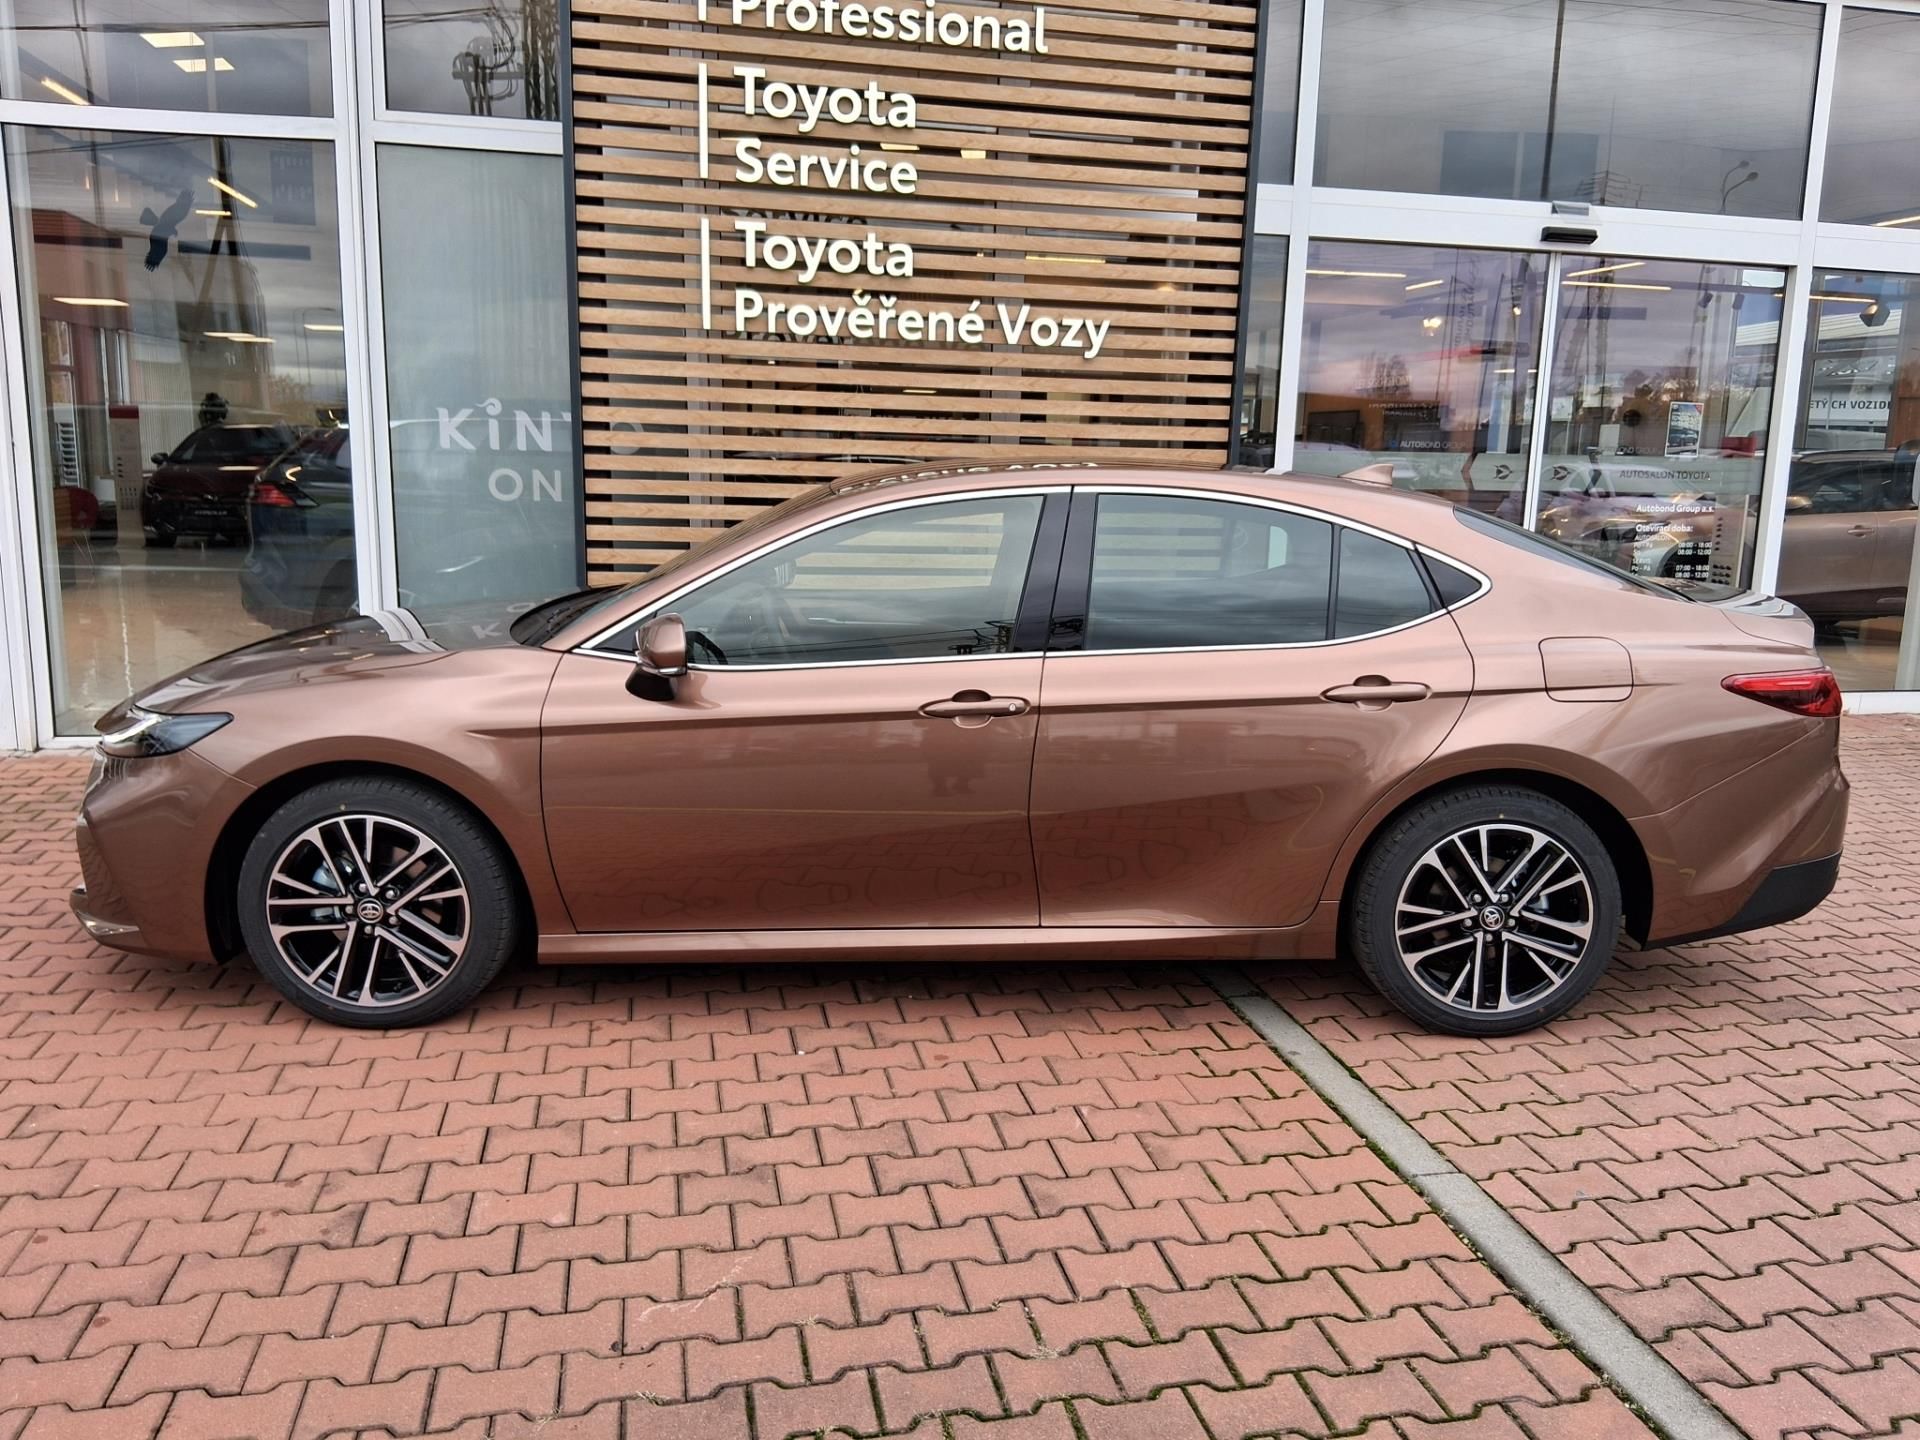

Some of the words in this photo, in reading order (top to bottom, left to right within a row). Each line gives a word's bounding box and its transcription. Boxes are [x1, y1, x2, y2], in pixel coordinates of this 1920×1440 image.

[732, 0, 1049, 53] Professional
[733, 66, 917, 132] Toyota
[735, 138, 919, 193] Service
[734, 220, 914, 283] Toyota
[735, 289, 985, 344] Prověřené
[997, 303, 1111, 359] Vozy
[1620, 470, 1674, 479] AUTOSALON
[1676, 471, 1710, 480] TOYOTA
[1636, 504, 1675, 513] Autobond
[1676, 504, 1700, 514] Group
[1701, 505, 1715, 513] a.s.
[1671, 524, 1694, 532] doba:
